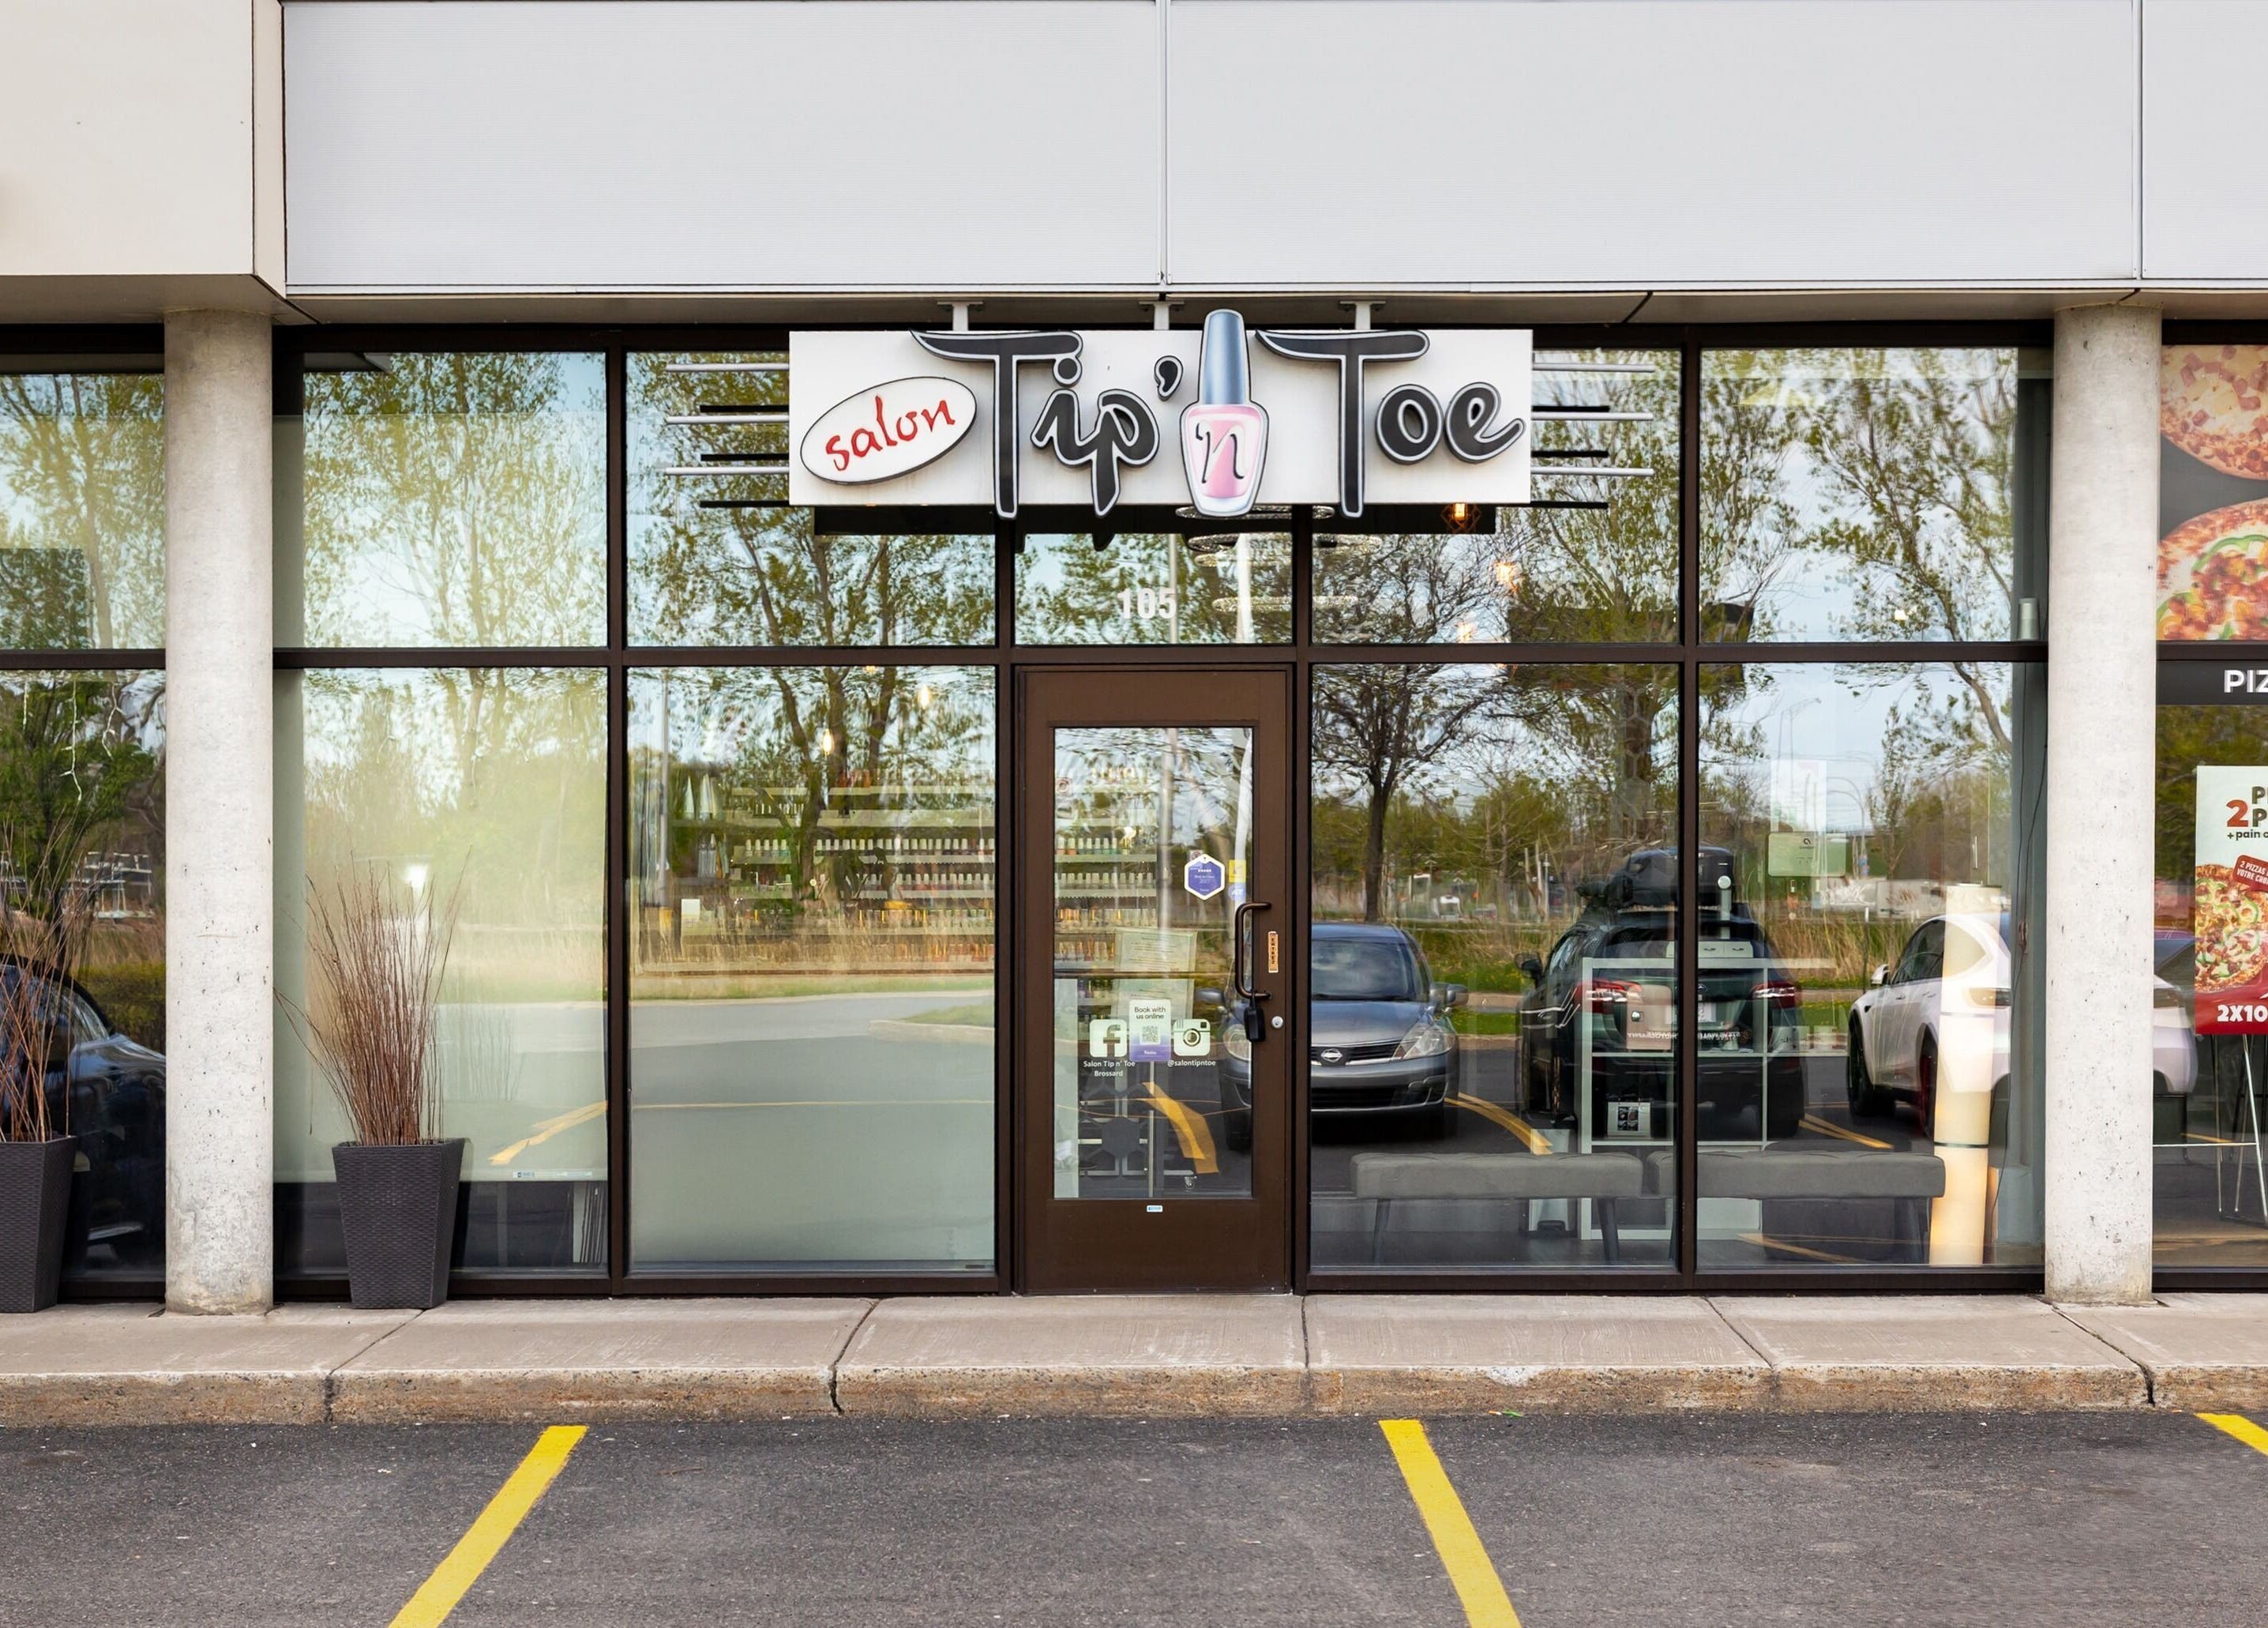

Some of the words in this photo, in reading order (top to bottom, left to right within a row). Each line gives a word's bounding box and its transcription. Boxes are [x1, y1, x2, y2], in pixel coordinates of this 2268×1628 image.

[825, 395, 956, 472] salon
[910, 329, 1183, 518] Tip'
[1255, 329, 1526, 518] Toe
[1117, 587, 1177, 619] 105
[2226, 799, 2248, 827] 2
[2236, 829, 2261, 841] pain
[2236, 867, 2255, 880] VOTRE
[2245, 863, 2266, 875] PIZZAS
